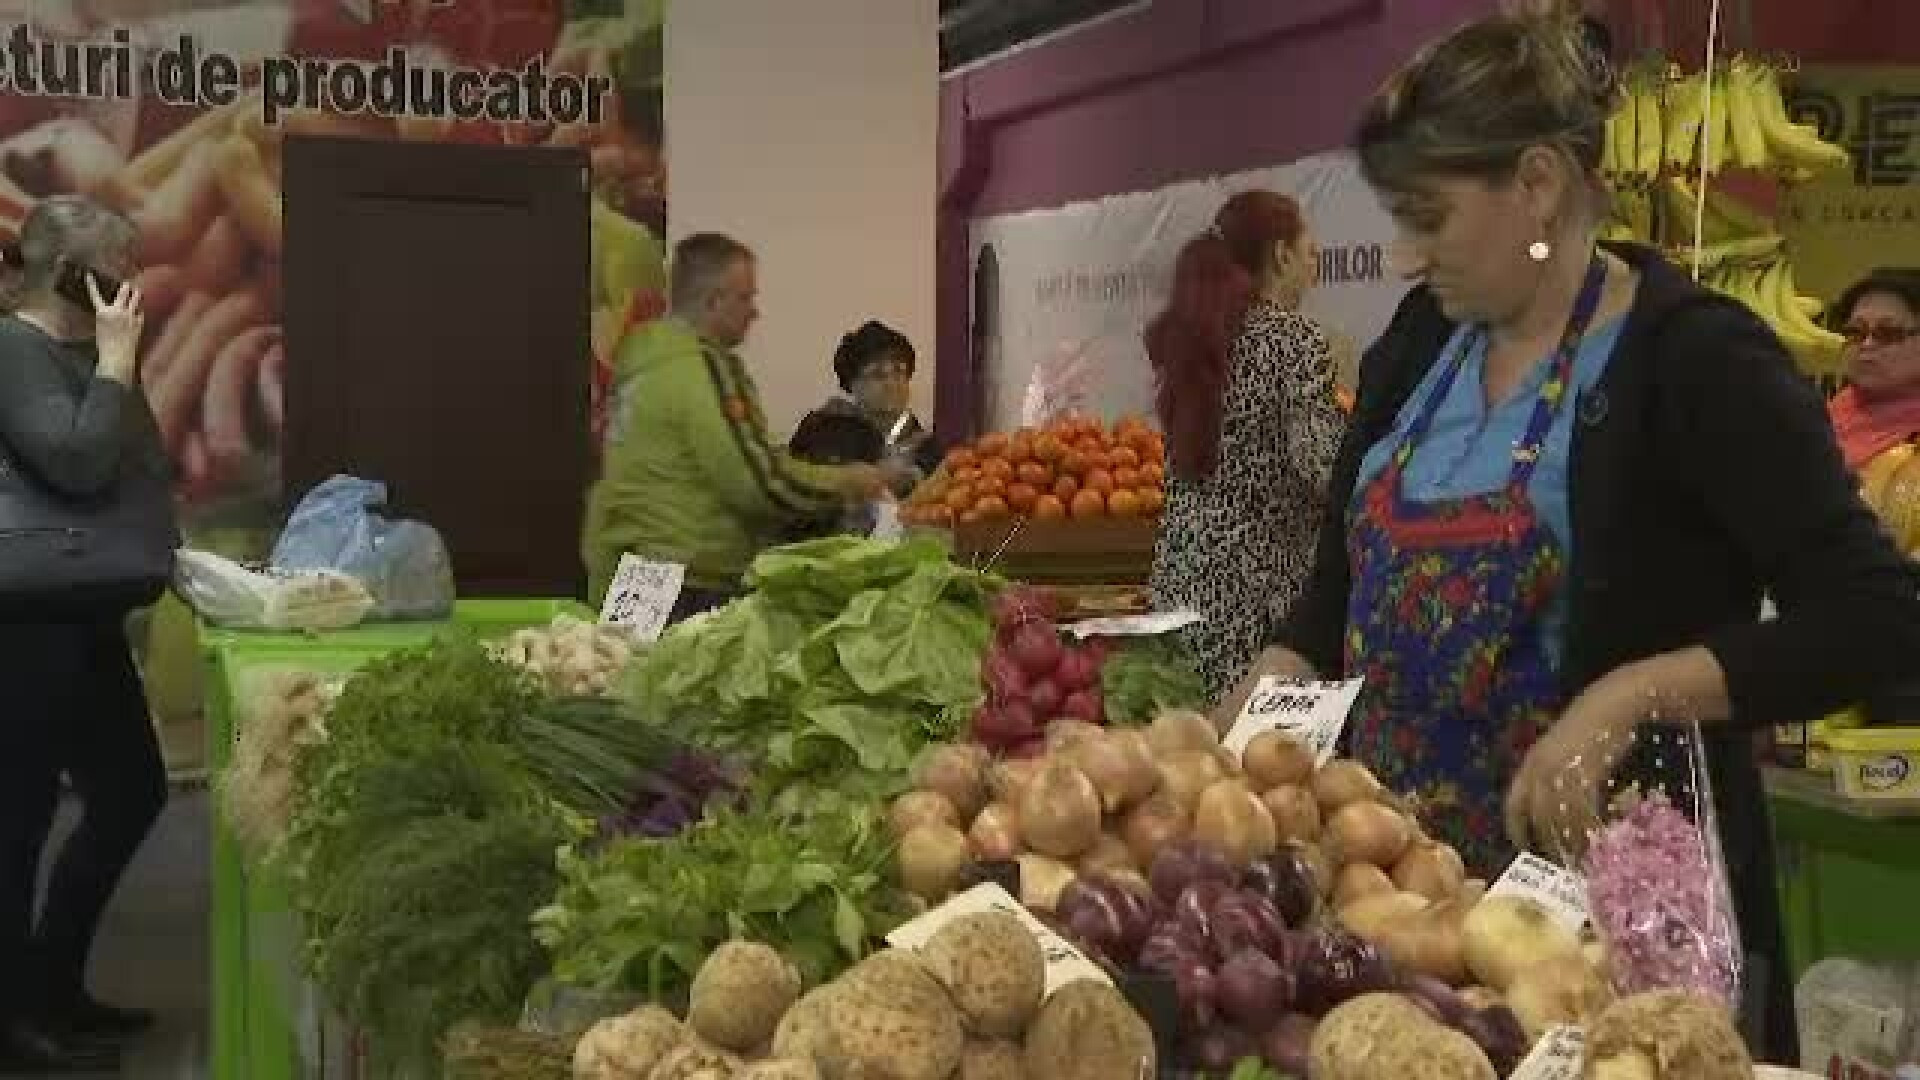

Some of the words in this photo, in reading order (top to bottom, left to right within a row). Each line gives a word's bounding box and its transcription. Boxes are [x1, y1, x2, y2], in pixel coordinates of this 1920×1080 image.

[0, 23, 131, 97] turi
[156, 34, 239, 106] de
[263, 48, 611, 125] producator
